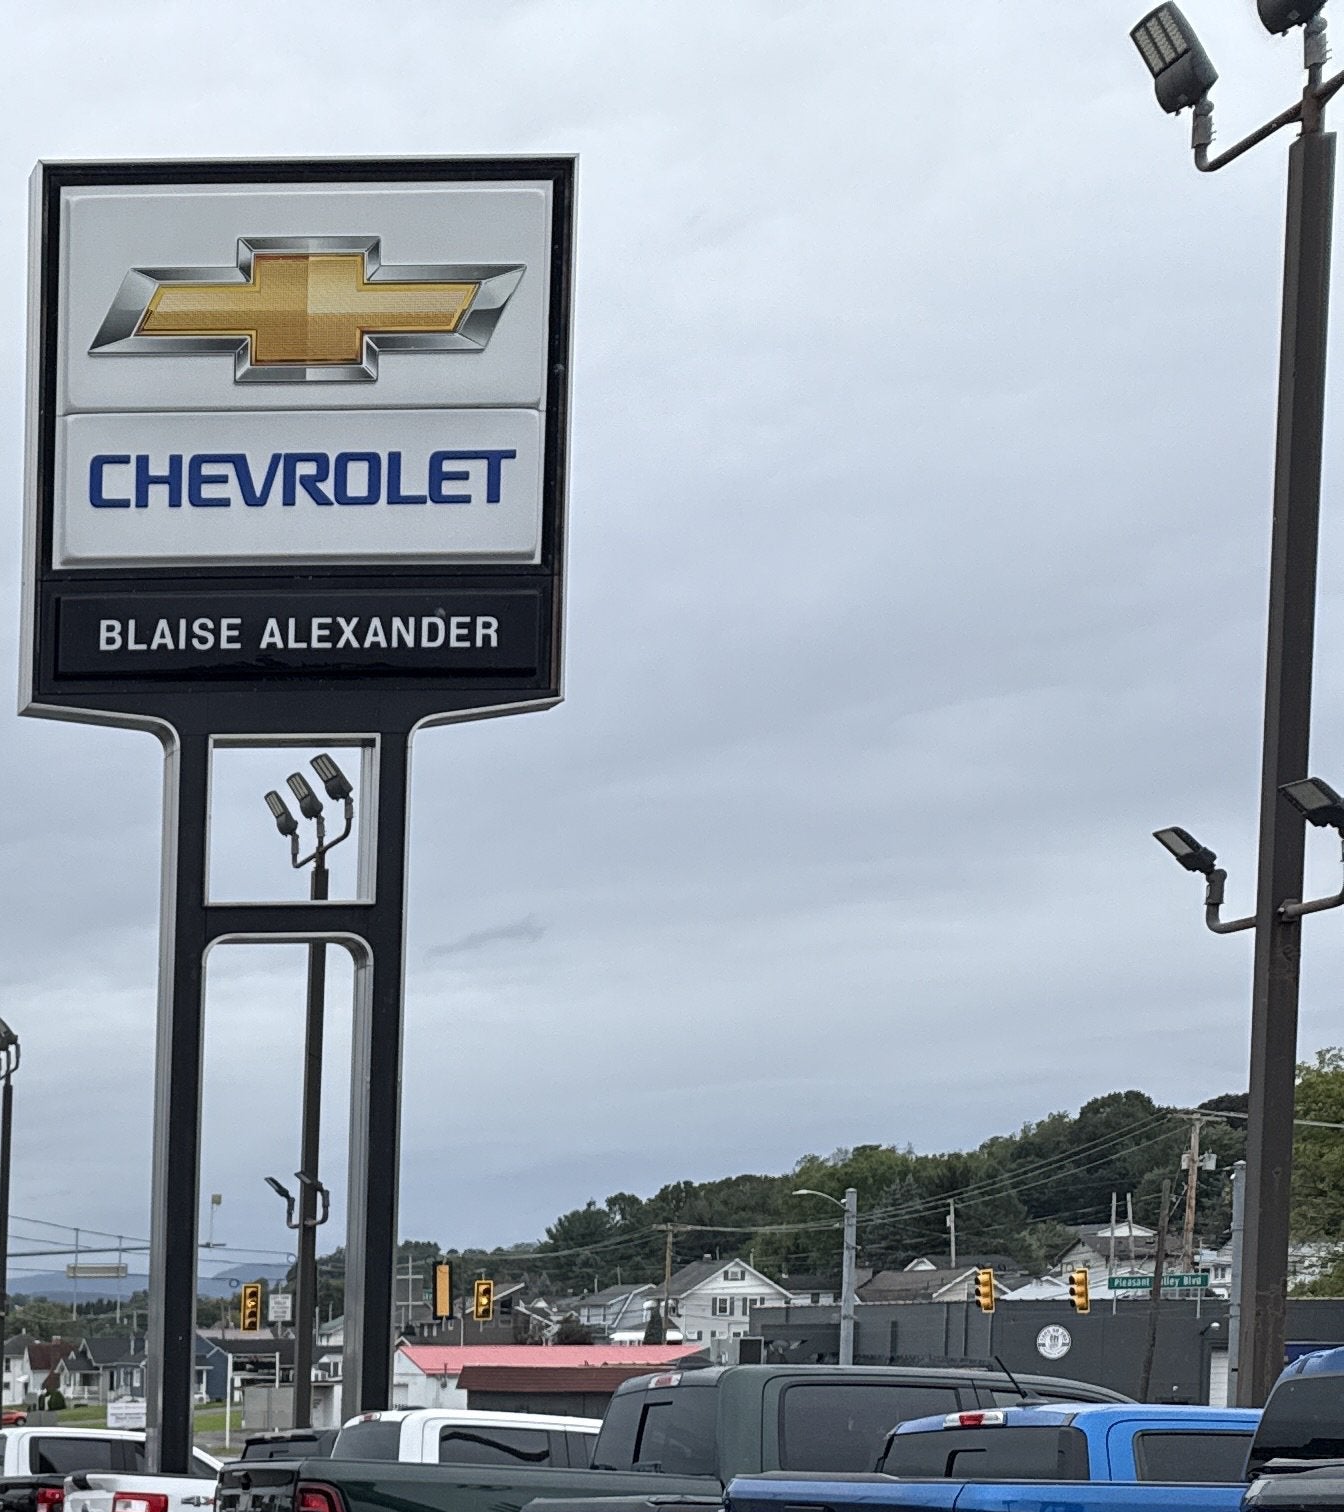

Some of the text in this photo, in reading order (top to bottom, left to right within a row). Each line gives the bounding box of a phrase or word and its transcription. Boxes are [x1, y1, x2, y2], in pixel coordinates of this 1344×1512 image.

[88, 449, 517, 508] CHEVROLET
[99, 616, 499, 651] BLAISE ALEXANDER
[1114, 1278, 1150, 1287] Pleasant
[1183, 1276, 1202, 1286] Blvd
